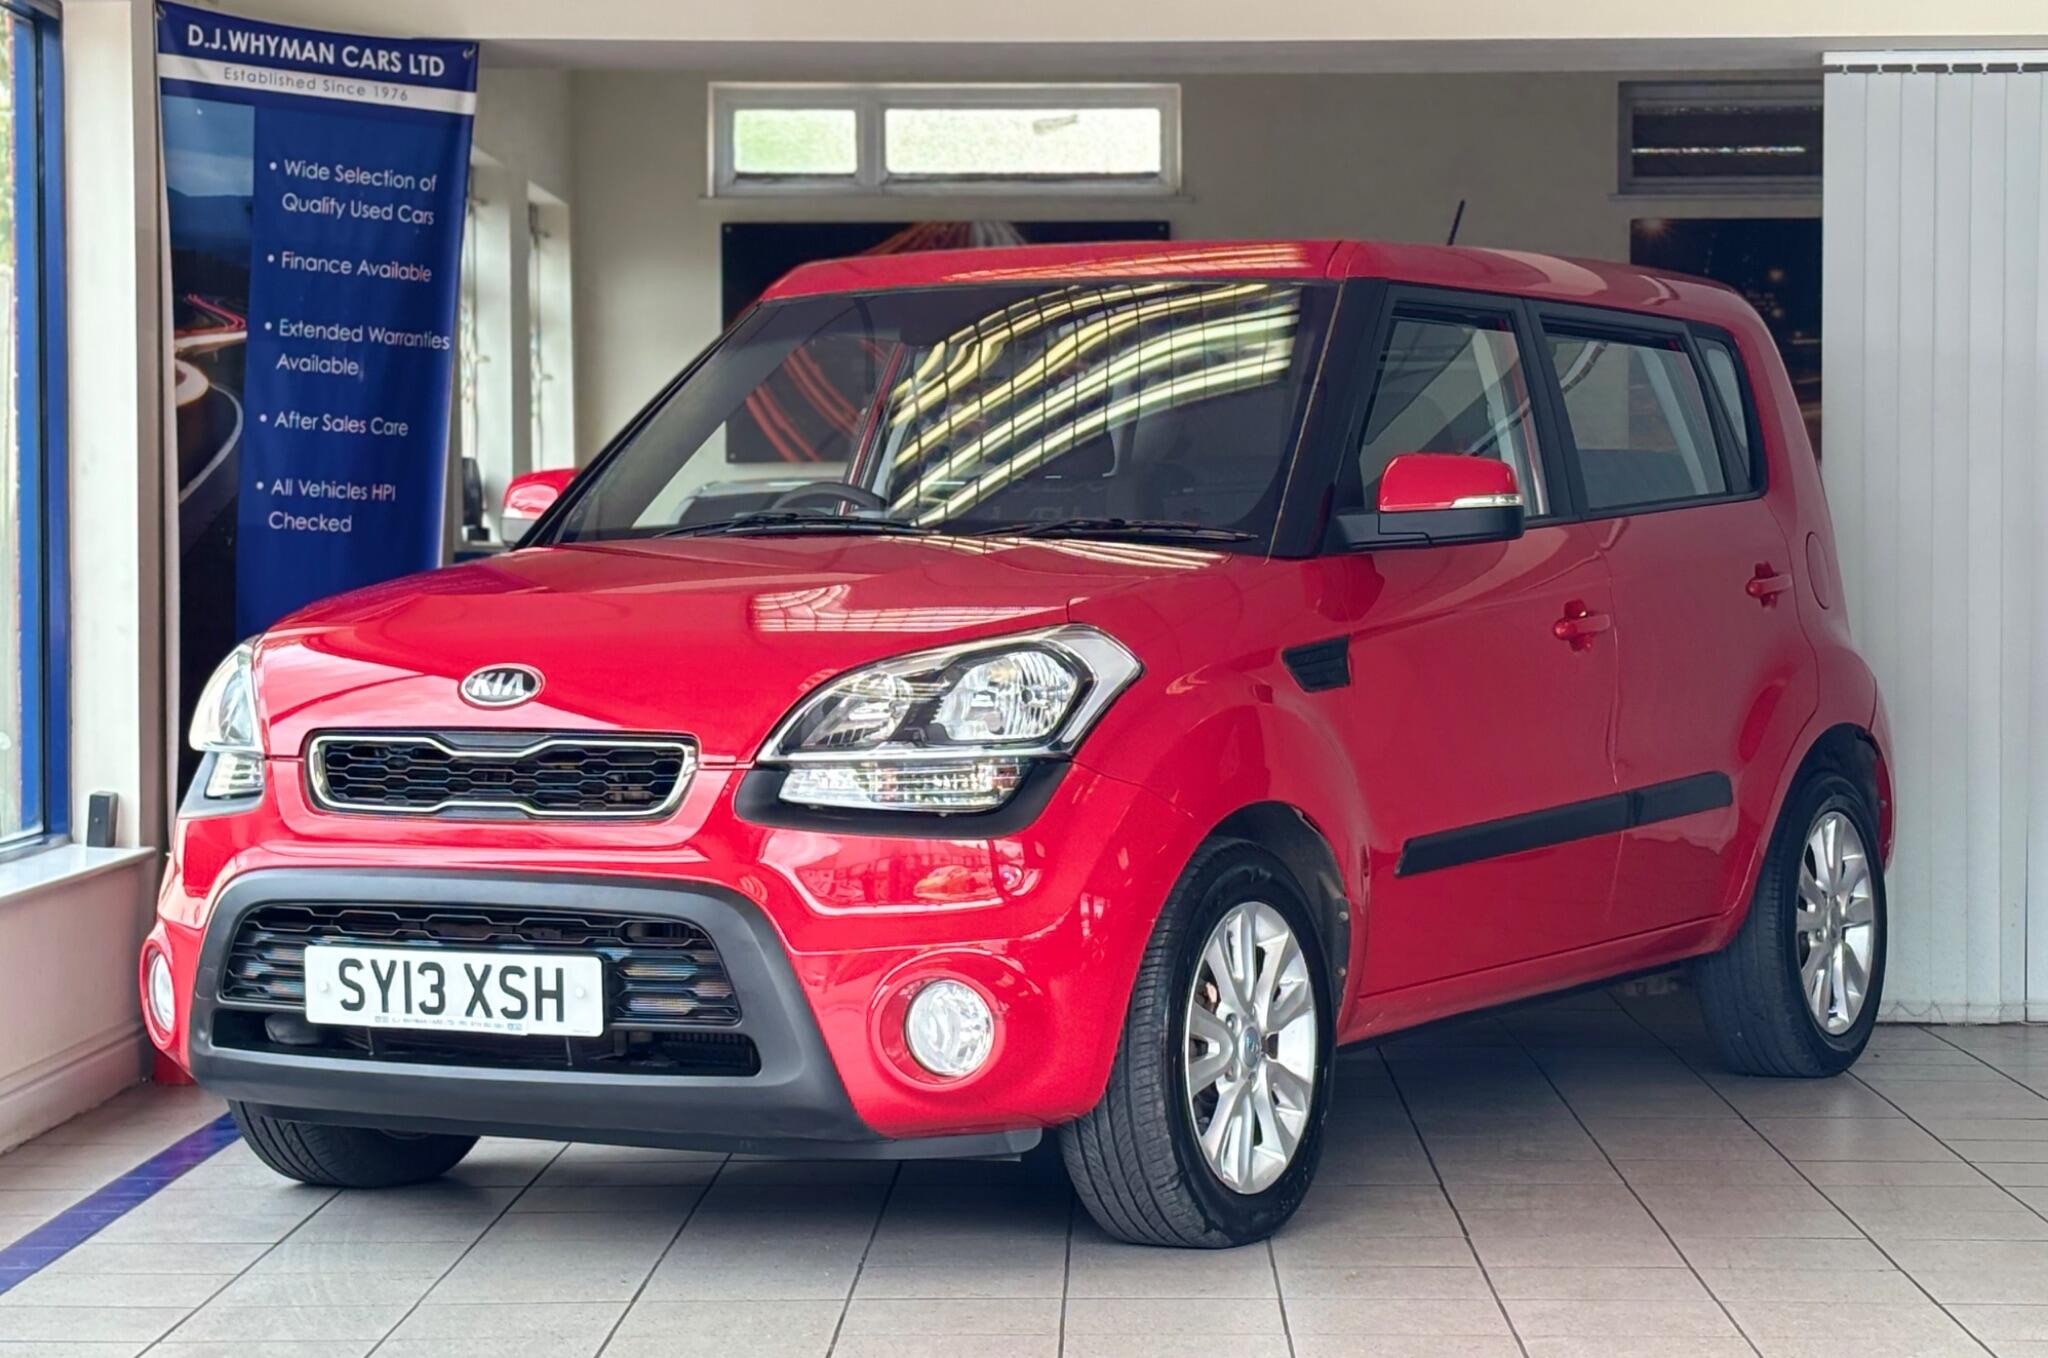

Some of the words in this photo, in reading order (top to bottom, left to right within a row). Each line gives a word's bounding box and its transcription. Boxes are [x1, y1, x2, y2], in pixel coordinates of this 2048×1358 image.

[187, 24, 335, 65] D.J.WHYMAN
[342, 45, 402, 73] CARS
[409, 53, 445, 77] LTD
[224, 67, 317, 91] Established
[323, 79, 366, 96] Since
[374, 85, 408, 102] 1976
[284, 159, 330, 181] Wide
[335, 165, 415, 190] Selection
[419, 174, 438, 192] of
[281, 193, 345, 219] Quality
[350, 200, 393, 221] Used
[398, 205, 434, 225] Cars
[281, 251, 351, 275] Finance
[357, 259, 432, 282] Available
[279, 319, 363, 342] Extended
[368, 326, 450, 350] Warranties
[276, 354, 359, 376] Available
[274, 411, 319, 430] After
[322, 414, 366, 434] Sales
[370, 417, 409, 437] Care
[271, 479, 293, 497] All
[299, 480, 368, 500] Vehicles
[372, 484, 396, 501] HPI
[268, 511, 352, 532] Checked
[472, 672, 524, 696] KIA
[338, 958, 445, 1016] SY13
[463, 963, 564, 1022] XSH
